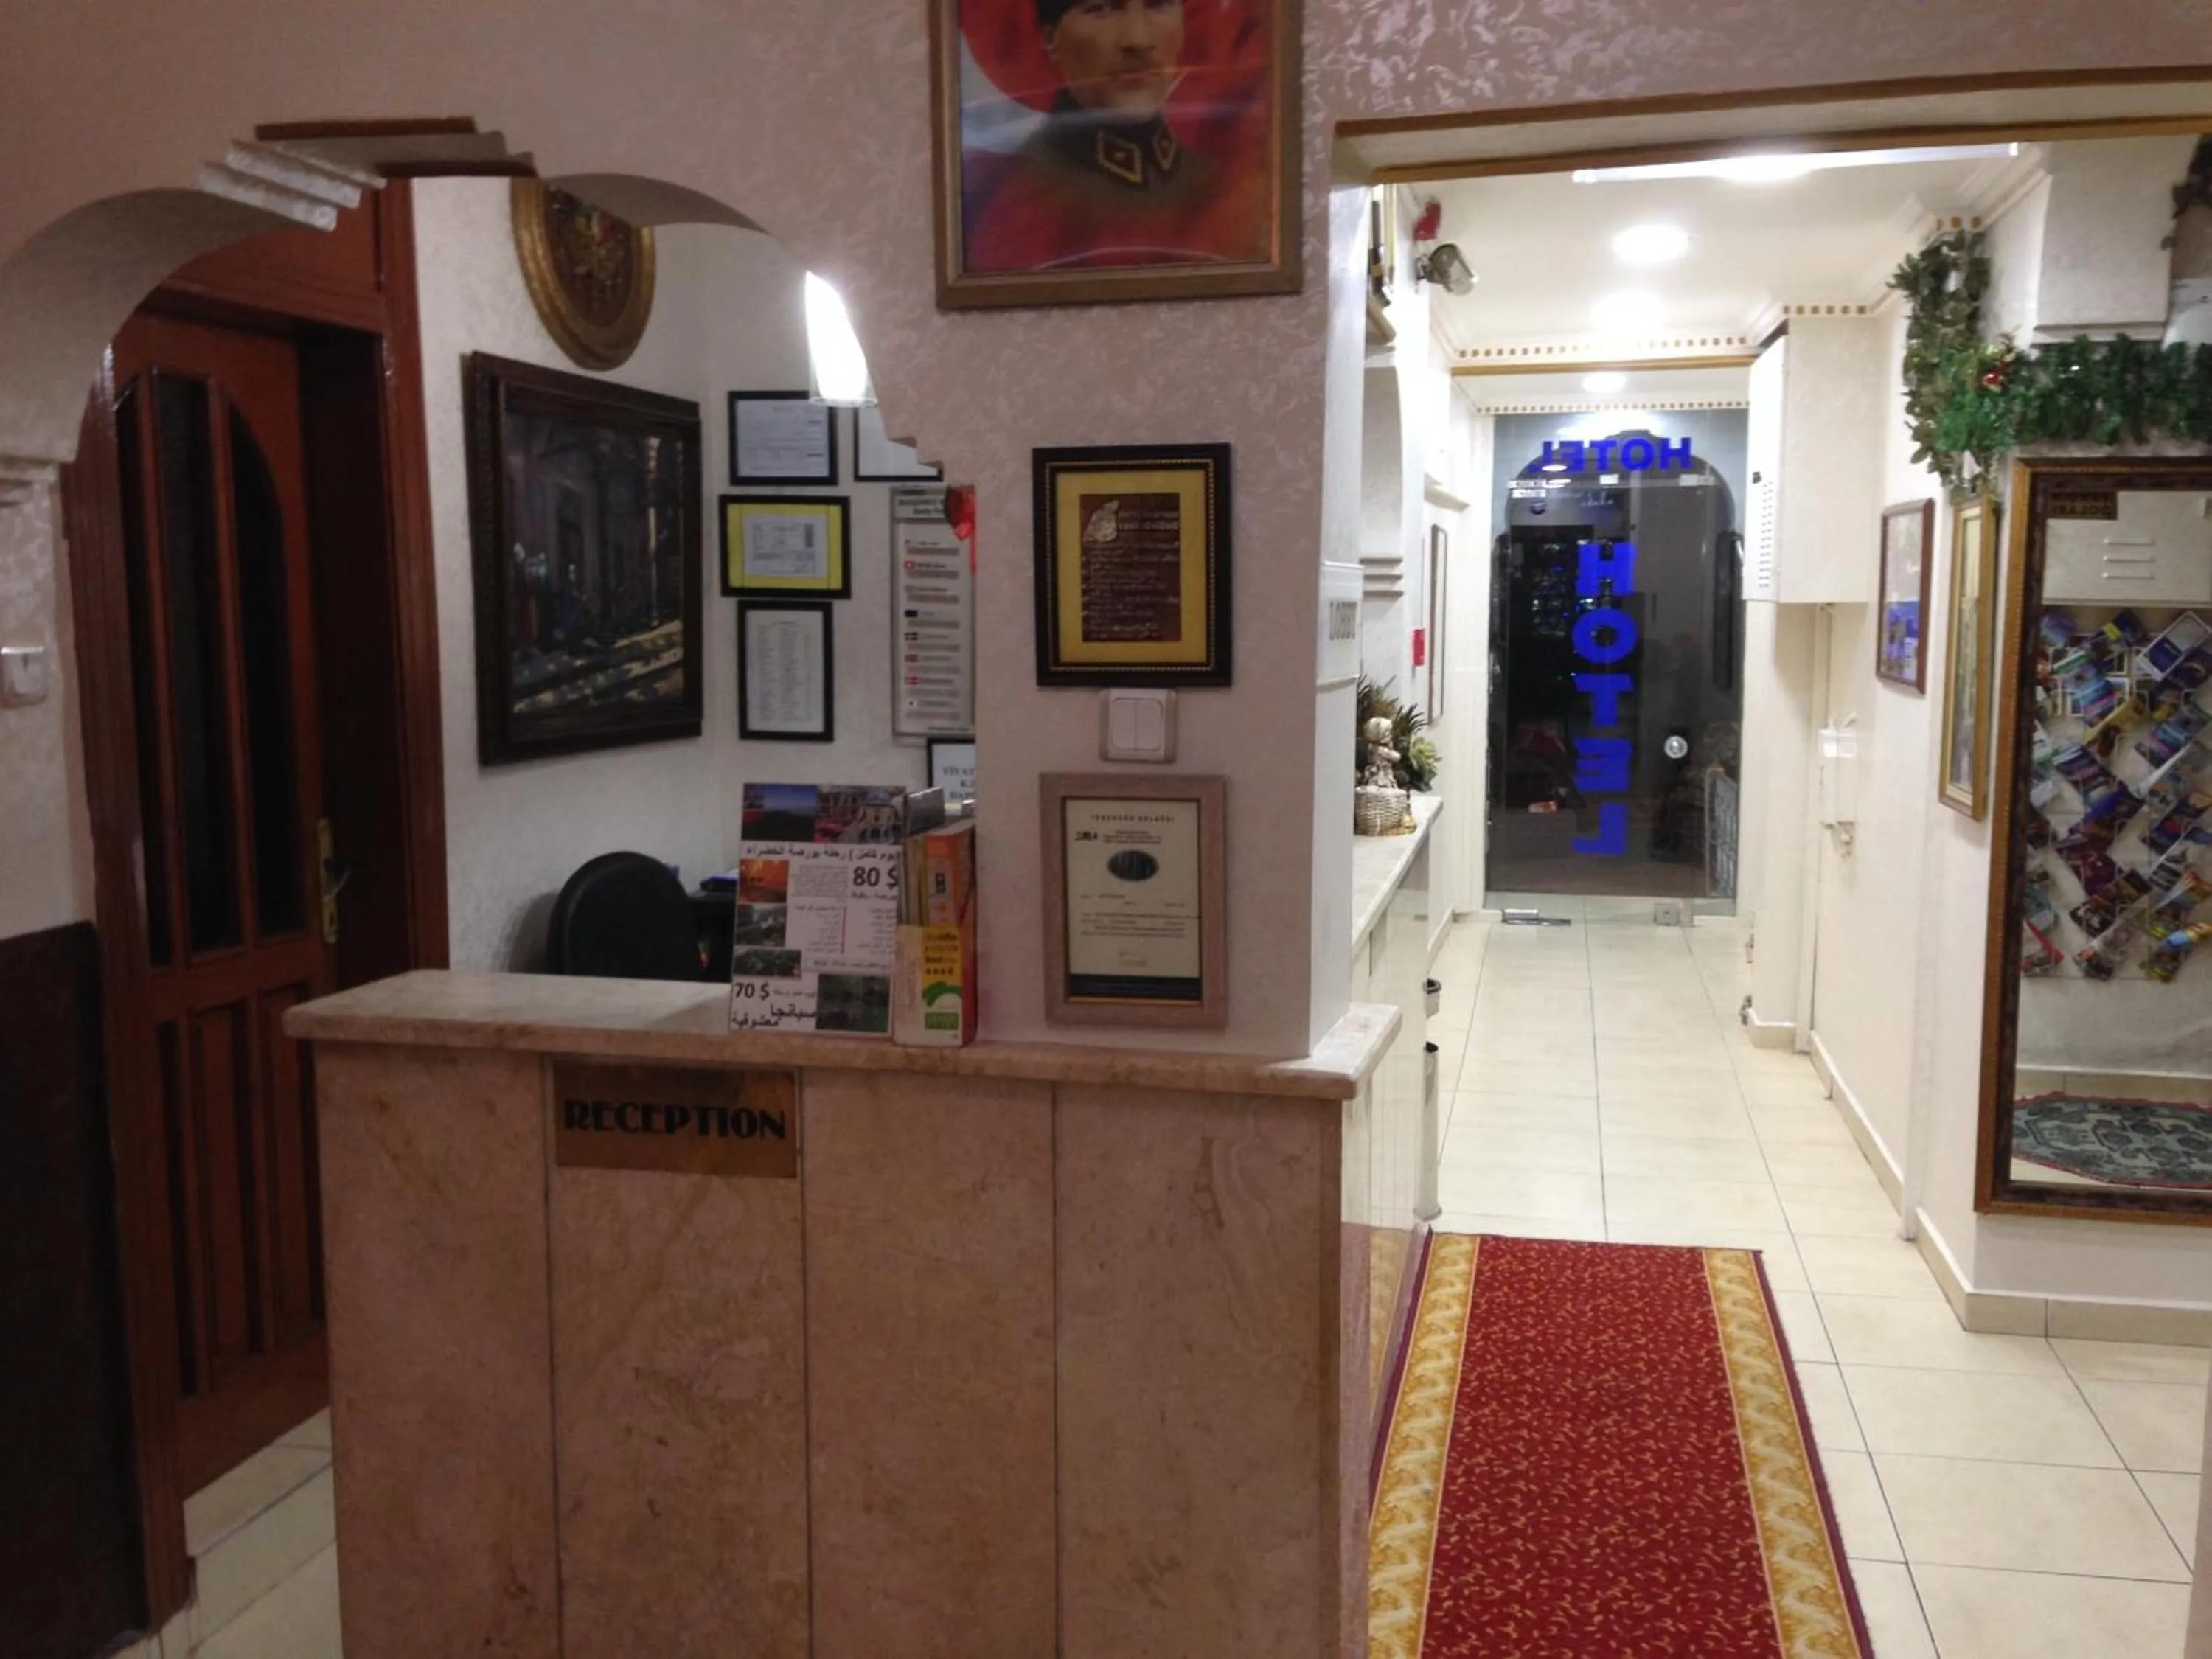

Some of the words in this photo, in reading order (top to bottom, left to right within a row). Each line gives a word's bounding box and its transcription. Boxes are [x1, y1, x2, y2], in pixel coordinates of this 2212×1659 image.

[852, 866, 881, 887] 80
[886, 863, 899, 891] $
[734, 982, 755, 998] 70
[759, 980, 771, 1001] $
[563, 1099, 787, 1140] RECEPTION
